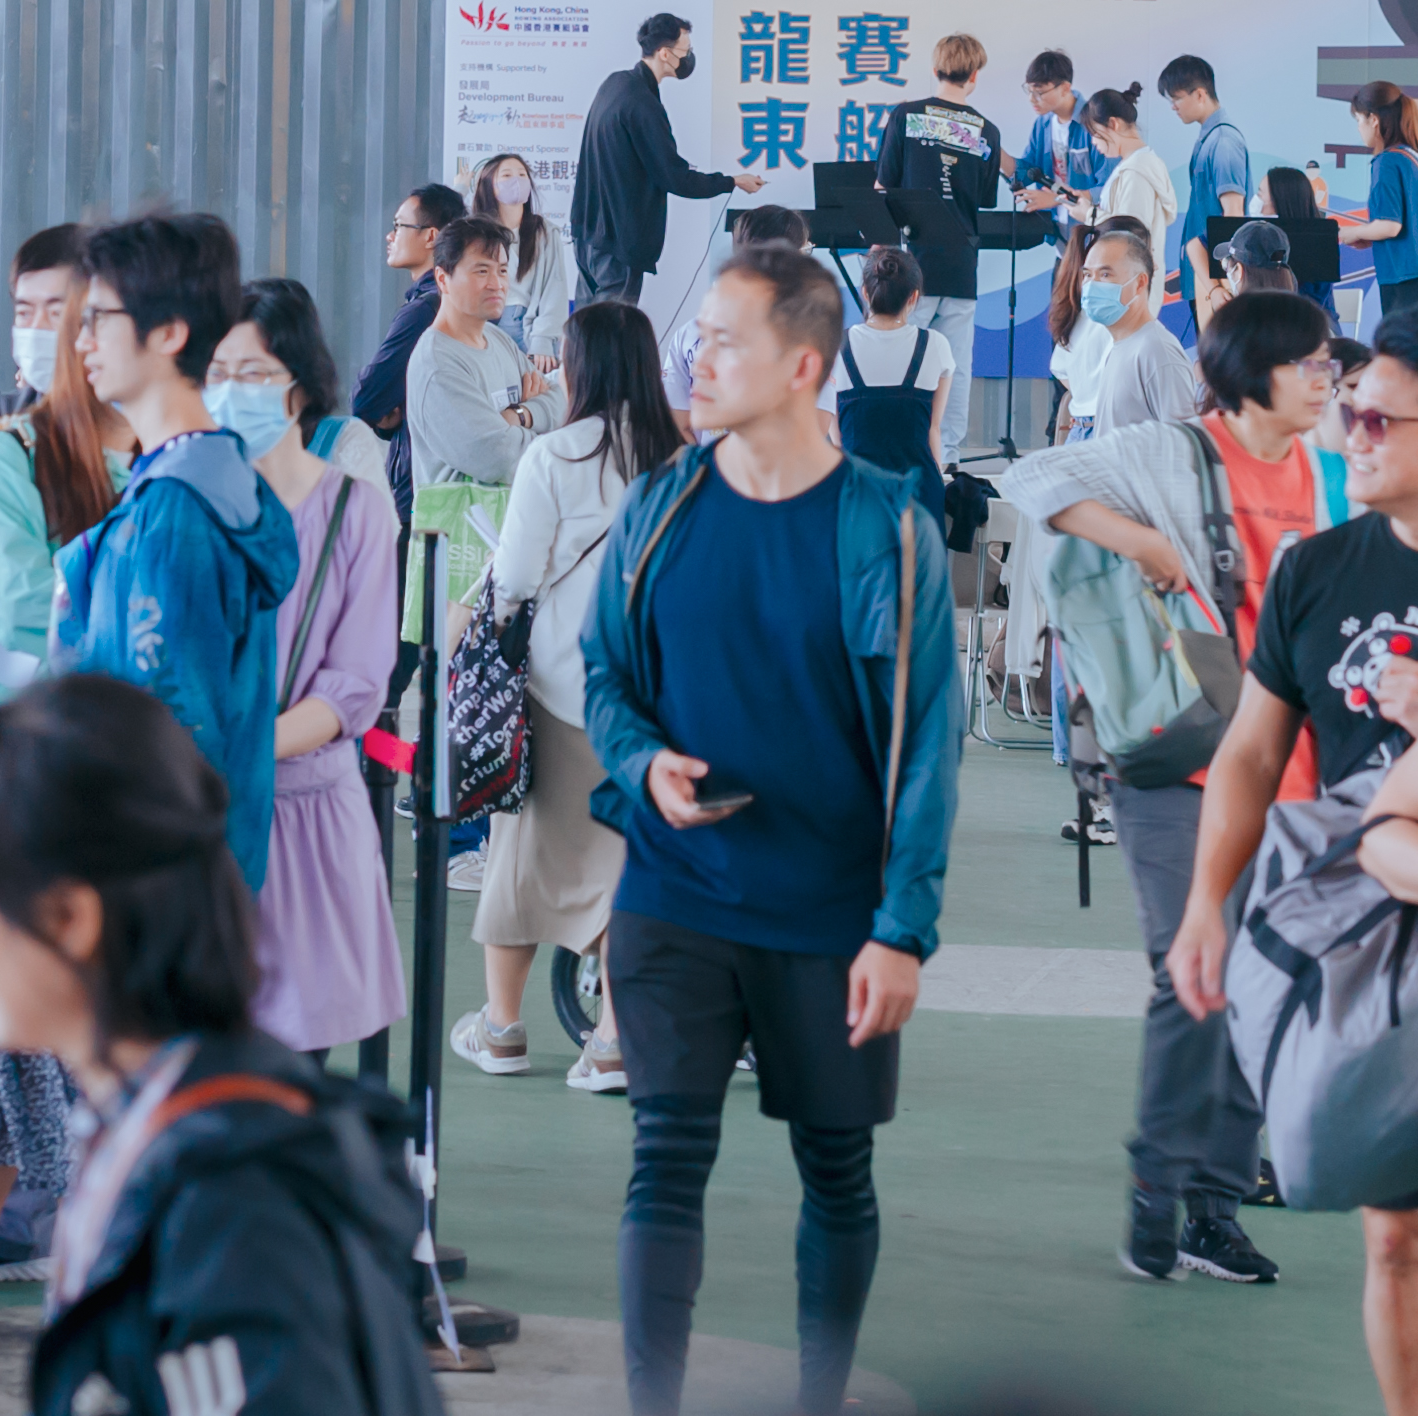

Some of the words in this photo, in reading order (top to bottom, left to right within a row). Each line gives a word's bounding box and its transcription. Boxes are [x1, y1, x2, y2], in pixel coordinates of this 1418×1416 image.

[514, 6, 537, 15] Hong
[539, 6, 563, 15] Kong,
[565, 6, 589, 15] China
[461, 39, 490, 47] Passion
[496, 64, 535, 74] Supported
[537, 64, 547, 74] by
[458, 92, 525, 103] Development
[527, 93, 564, 102] Bureau
[497, 144, 534, 154] Diamond
[536, 145, 570, 154] Sponsor
